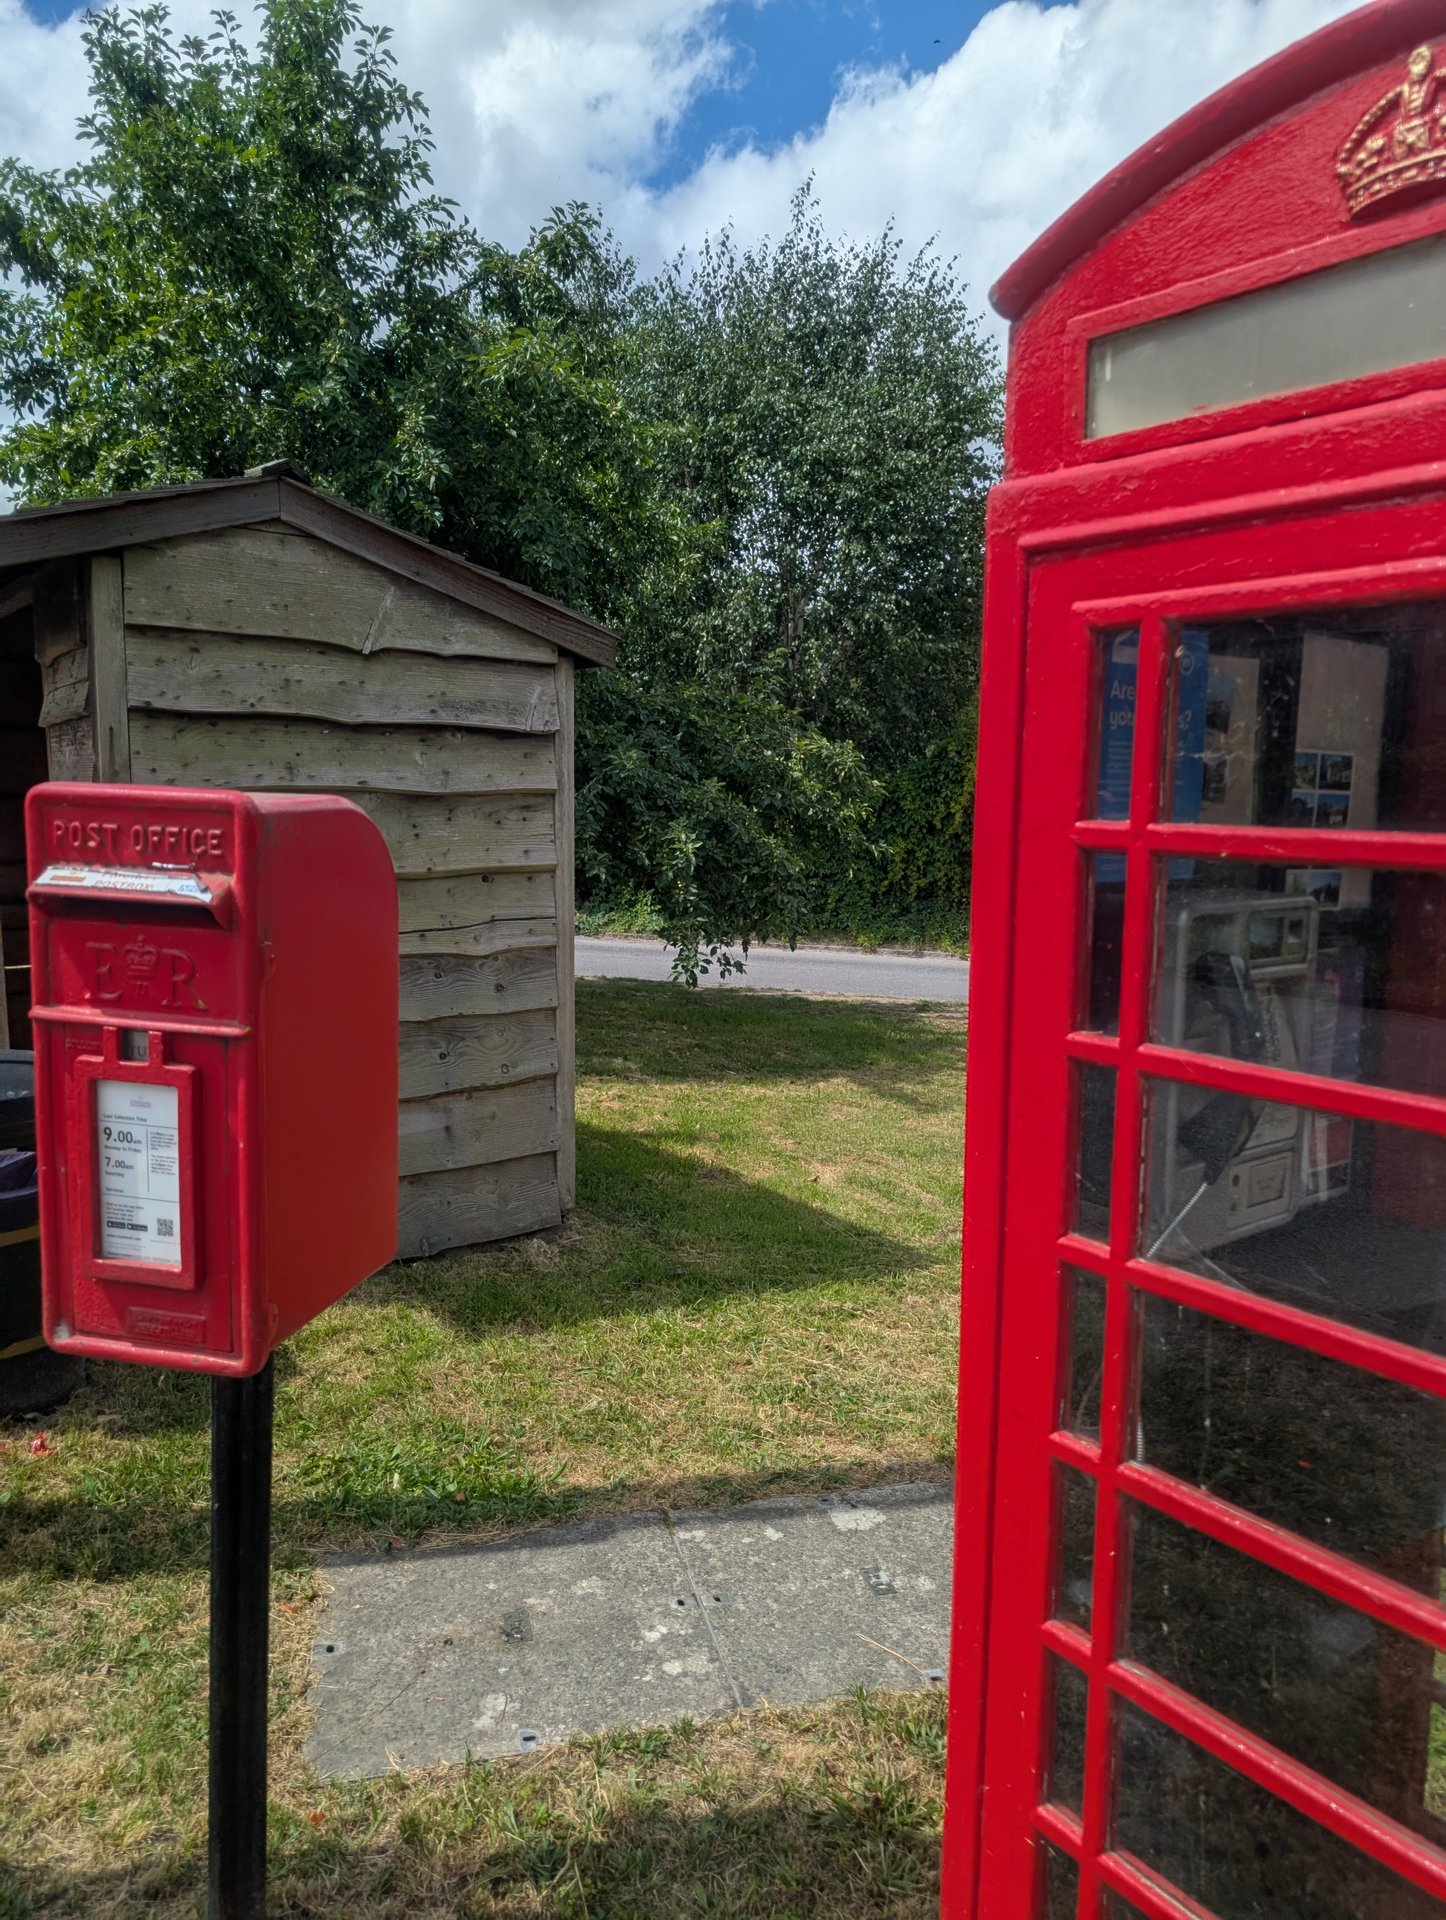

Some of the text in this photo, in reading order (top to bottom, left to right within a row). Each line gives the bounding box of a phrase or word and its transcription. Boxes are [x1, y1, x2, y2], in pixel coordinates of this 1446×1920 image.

[1110, 679, 1135, 700] Are
[53, 820, 223, 856] POST OFFICE
[161, 947, 208, 1011] R
[105, 1170, 125, 1178] Saturday
